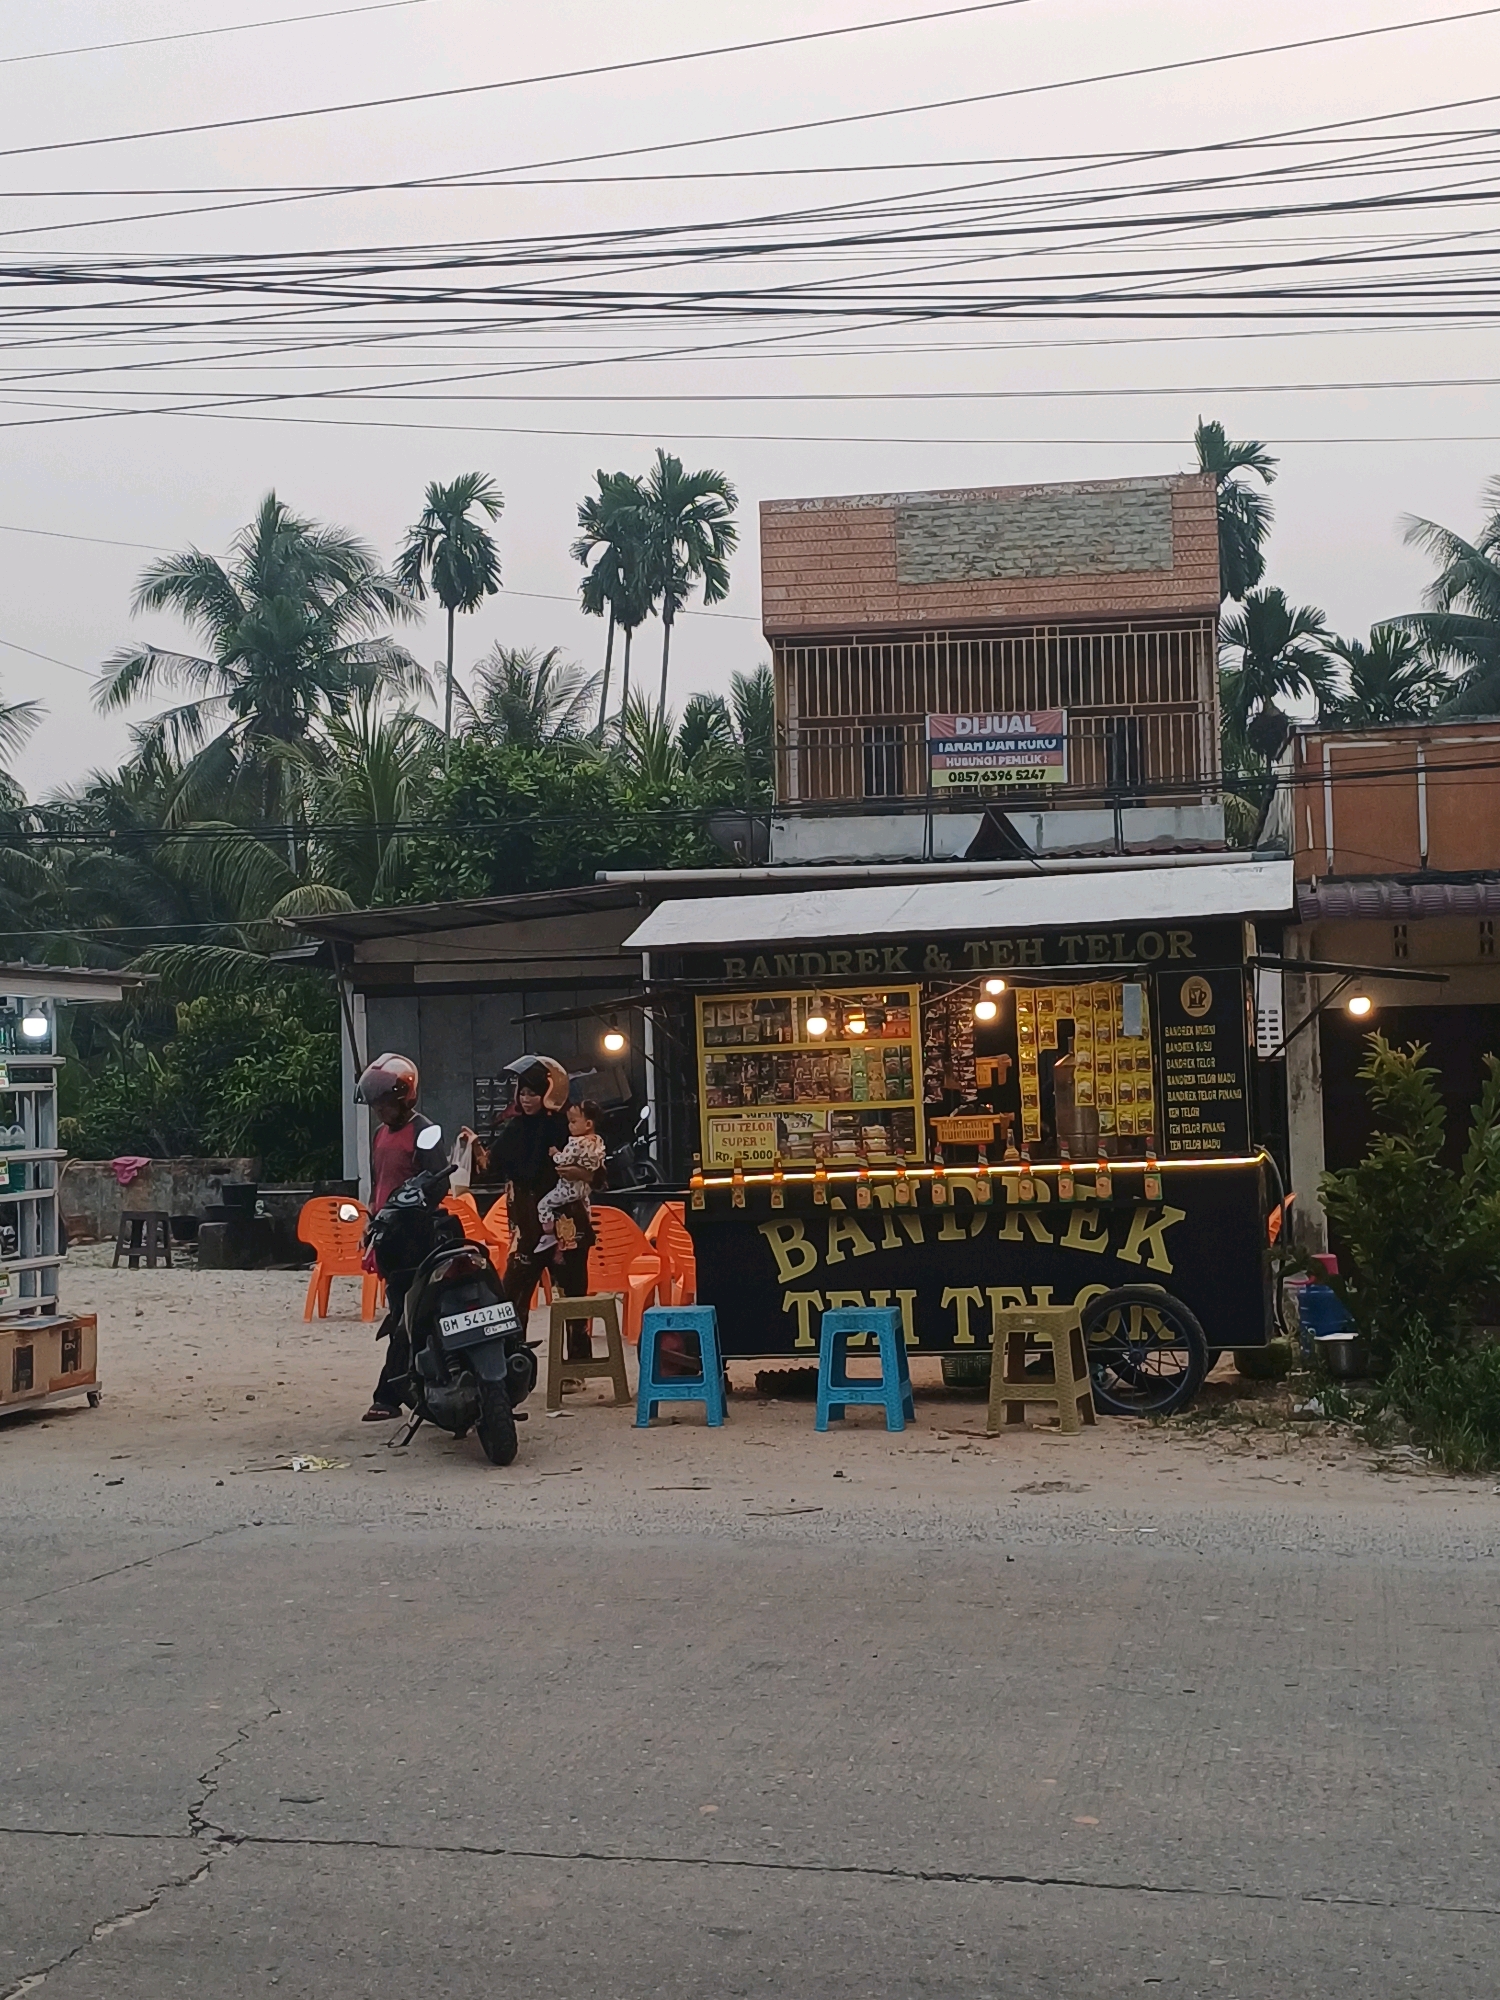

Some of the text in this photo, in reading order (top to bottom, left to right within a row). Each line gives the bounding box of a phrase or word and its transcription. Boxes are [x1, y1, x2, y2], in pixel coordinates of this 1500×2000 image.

[946, 756, 996, 767] HUBUNGI
[948, 771, 979, 783] 0857
[981, 770, 1013, 782] 6396
[723, 930, 1196, 978] BANDREK & TEH TELOR
[1196, 1057, 1216, 1068] TELOR
[1197, 1074, 1216, 1084] TELOR
[1198, 1090, 1217, 1100] TELOR
[737, 1122, 773, 1132] TELOR
[721, 1136, 757, 1146] SUPER
[1182, 1139, 1201, 1150] TELOR
[715, 1151, 733, 1162] Rp.
[757, 1175, 1186, 1284] BANDREK
[443, 1319, 459, 1332] BM
[464, 1310, 494, 1326] 5432
